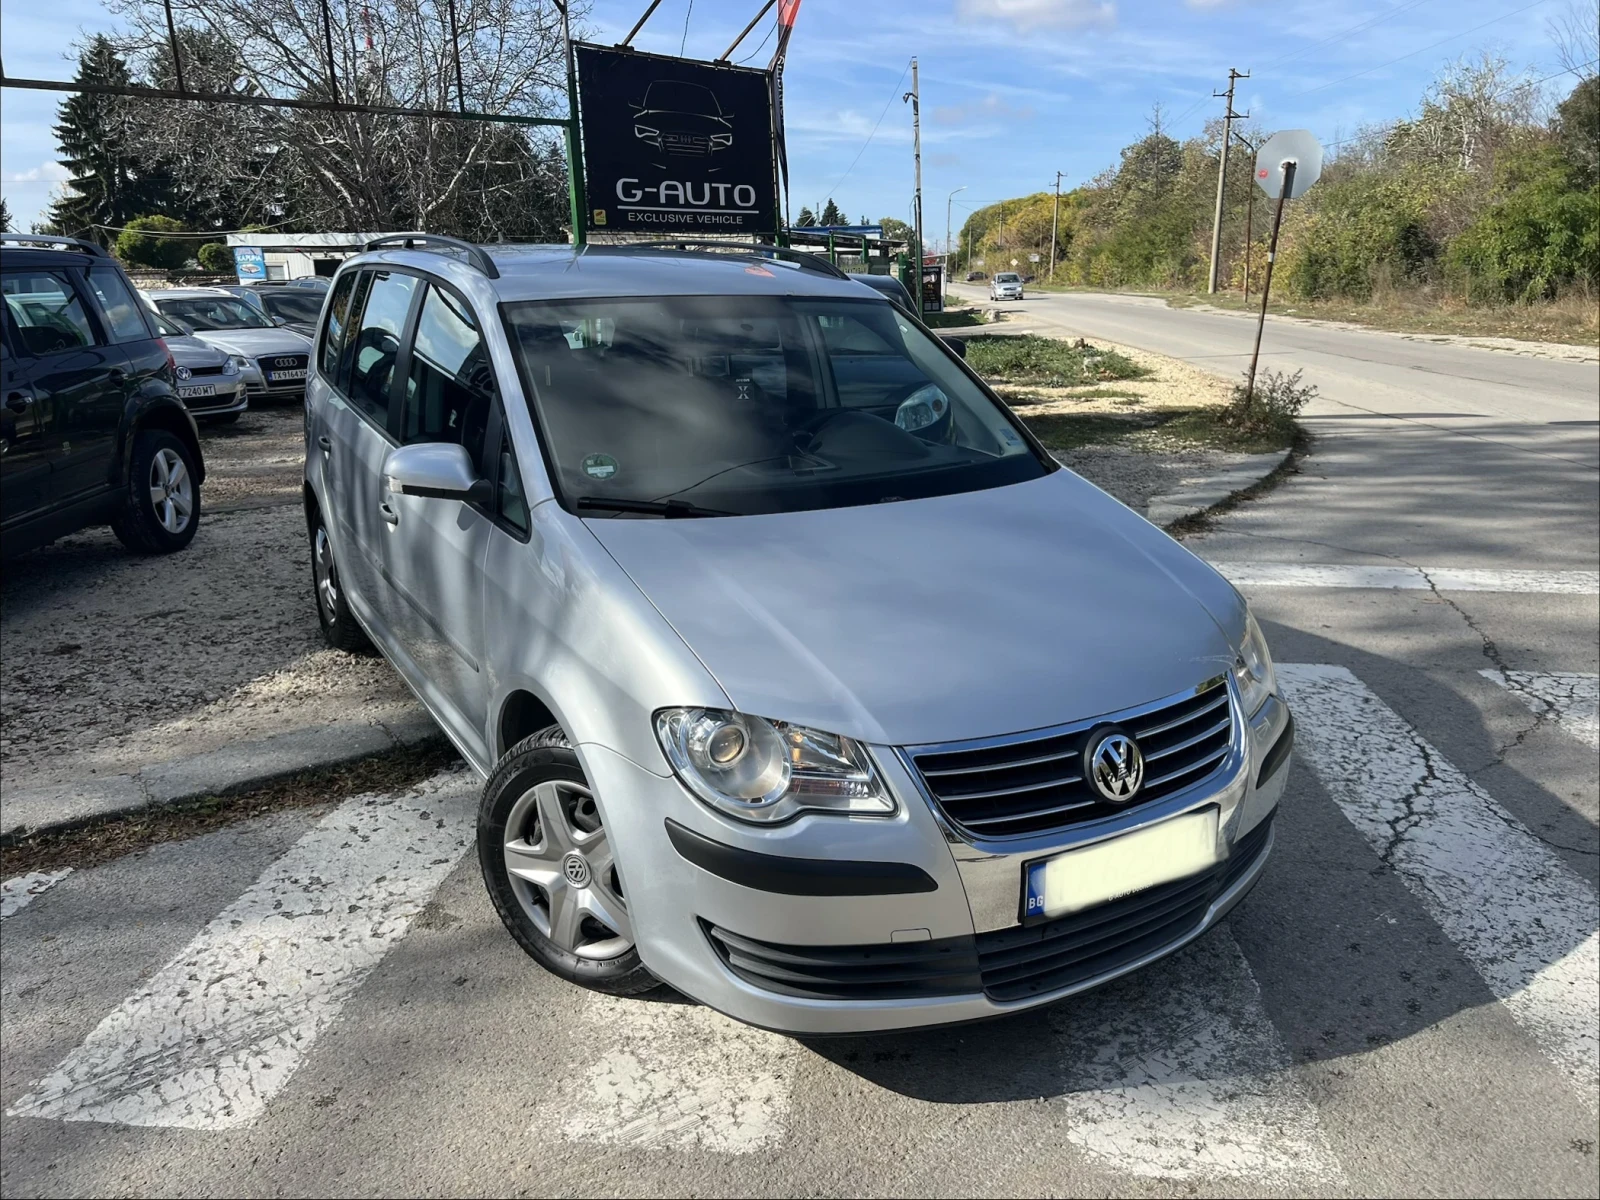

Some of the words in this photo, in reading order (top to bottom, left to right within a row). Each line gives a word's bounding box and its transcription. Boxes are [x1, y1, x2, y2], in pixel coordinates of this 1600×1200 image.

[616, 178, 756, 207] G-AUTO
[628, 212, 694, 223] EXCLUSIVE
[697, 214, 743, 225] VEHICLE
[1028, 895, 1044, 909] BG
